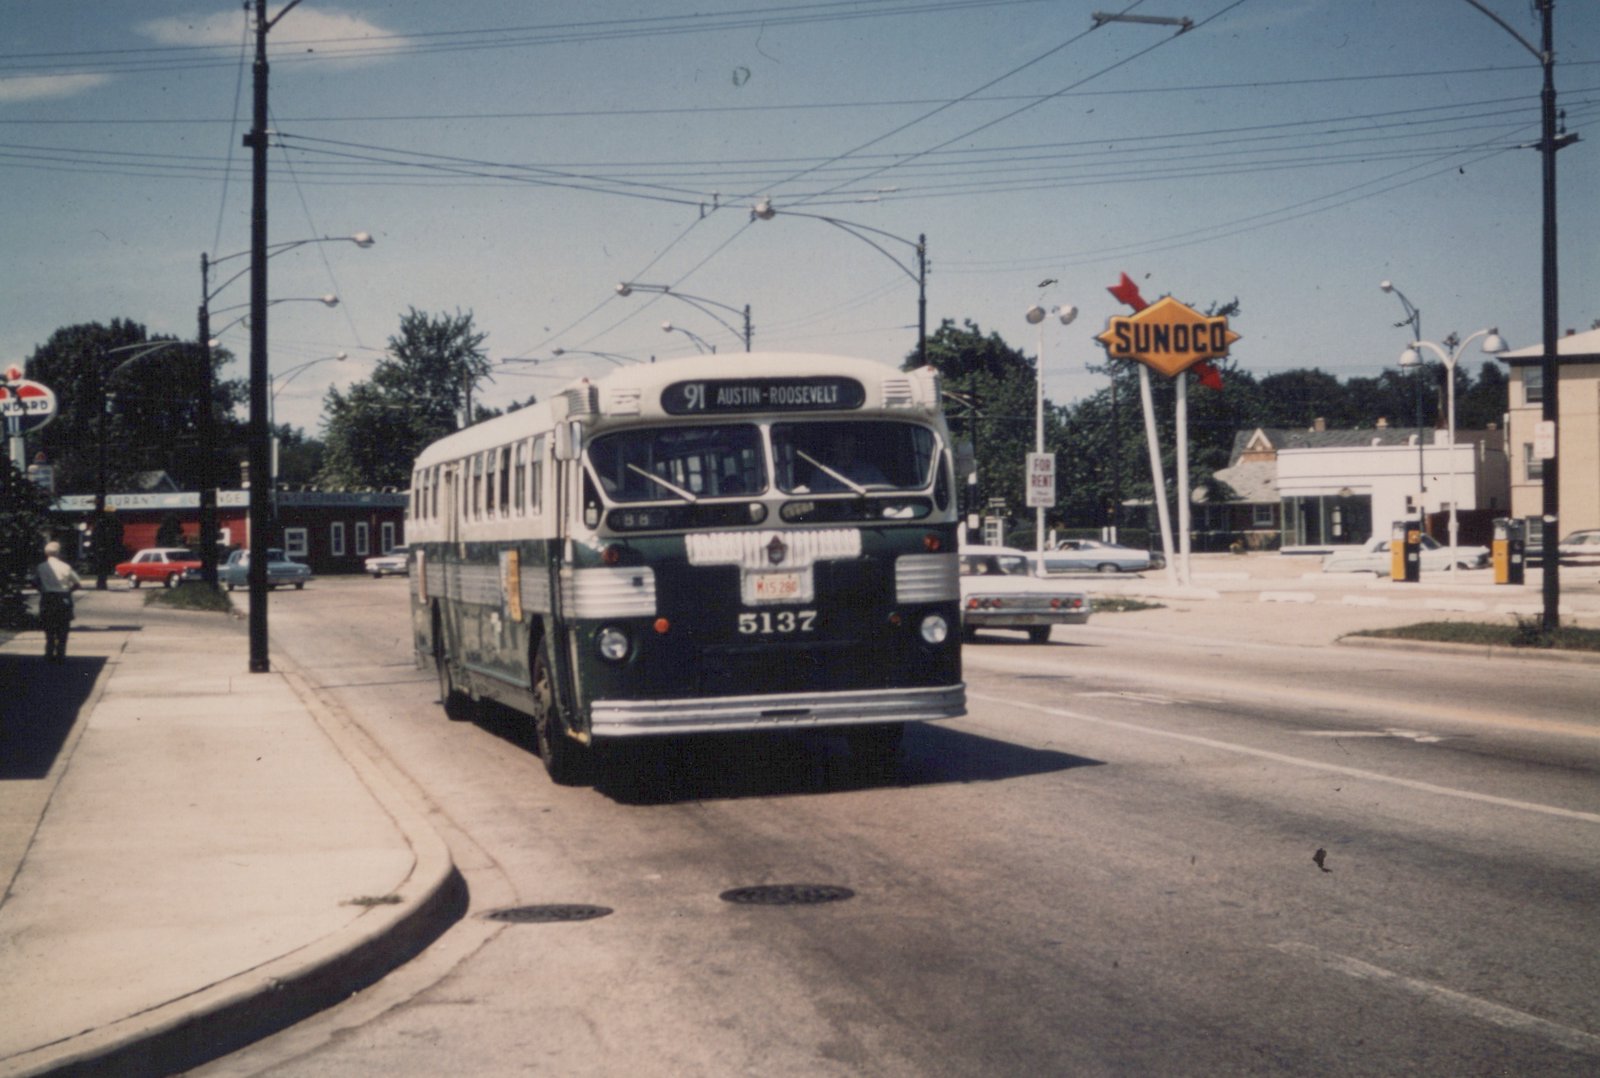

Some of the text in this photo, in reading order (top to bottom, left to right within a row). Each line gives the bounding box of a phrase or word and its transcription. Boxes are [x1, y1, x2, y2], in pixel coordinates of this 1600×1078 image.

[1115, 321, 1227, 353] SUNOCO
[683, 384, 838, 409] 91 AUSTIN-ROOSEVELT
[1033, 458, 1051, 472] FOR
[1031, 474, 1054, 488] RENT
[71, 495, 156, 507] REAURANT
[738, 610, 818, 634] 5137
